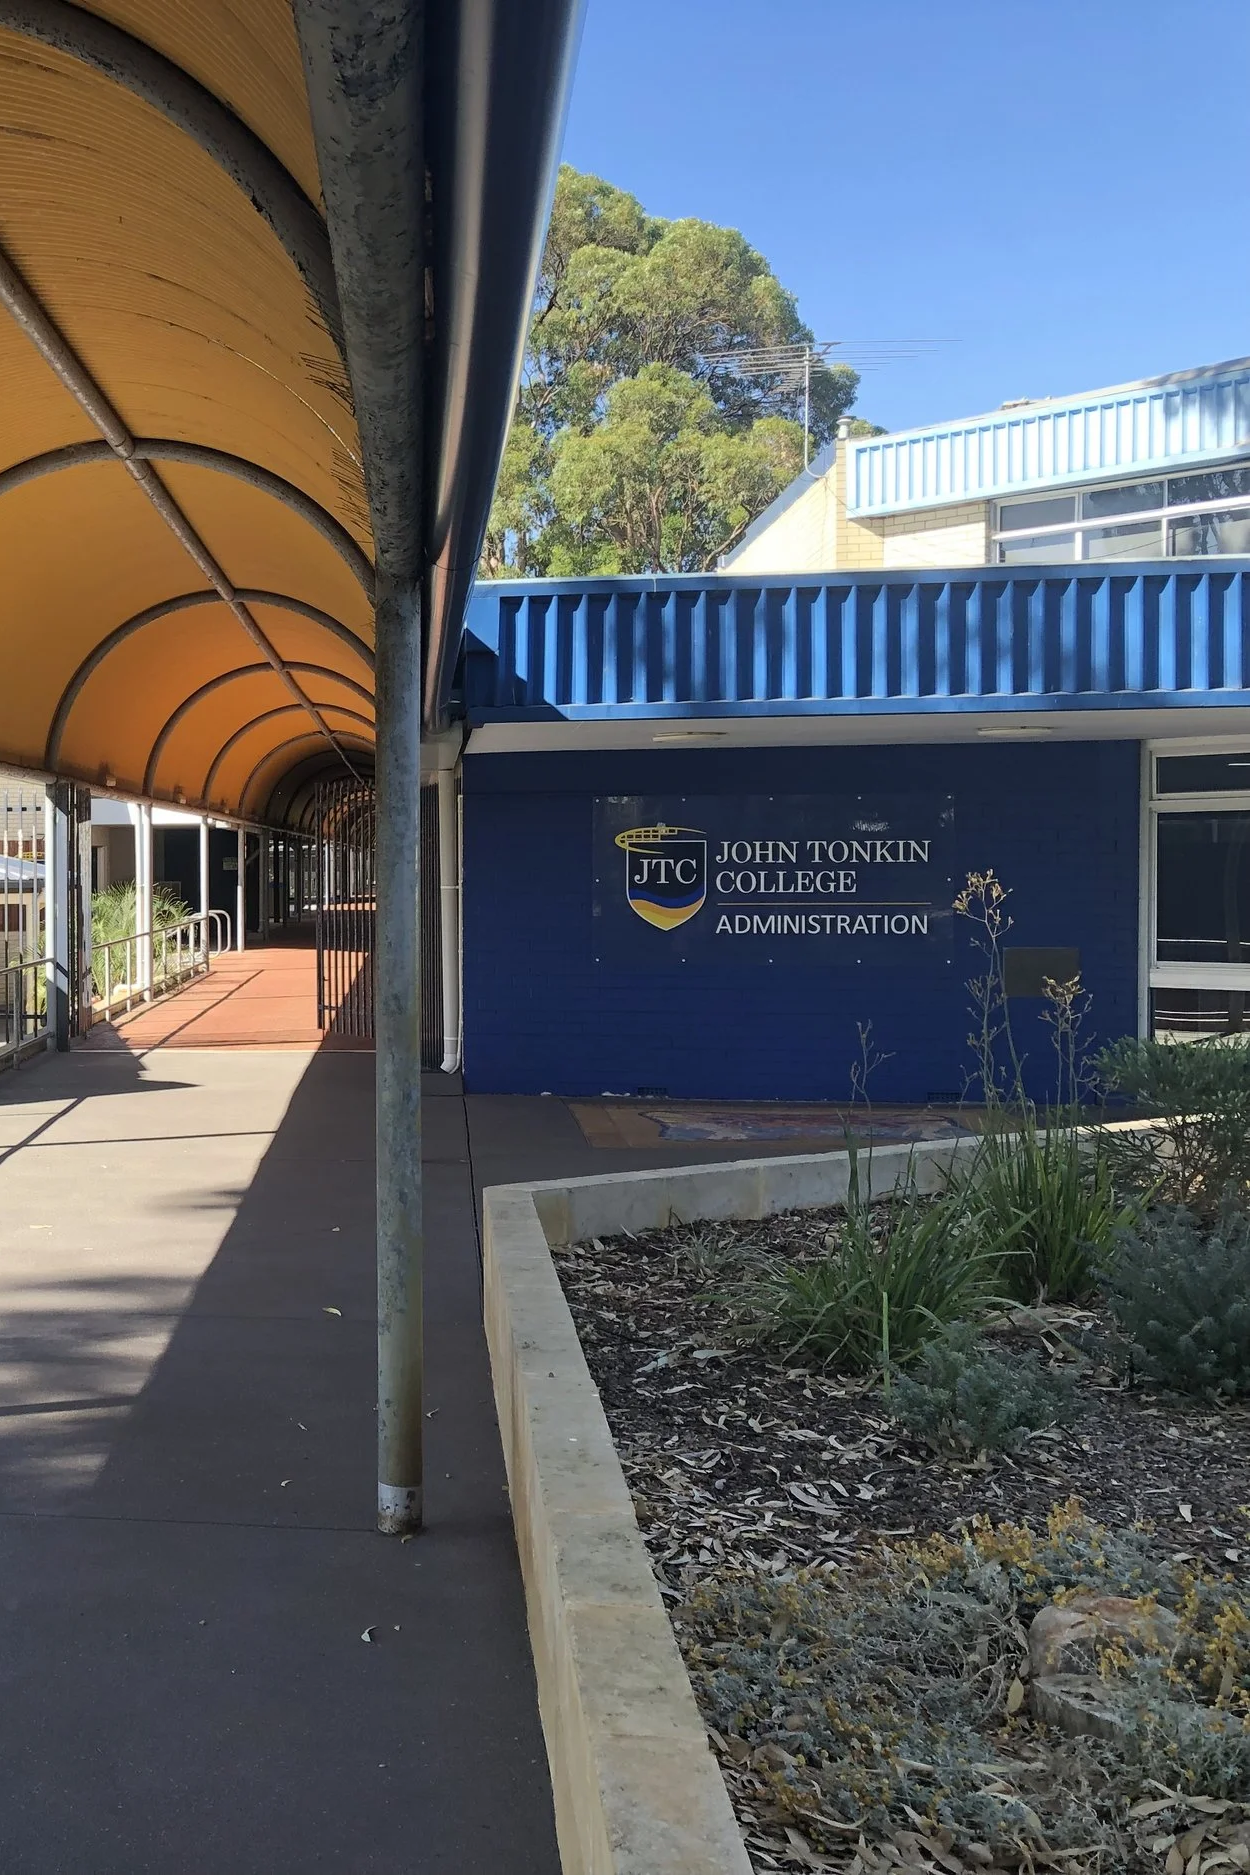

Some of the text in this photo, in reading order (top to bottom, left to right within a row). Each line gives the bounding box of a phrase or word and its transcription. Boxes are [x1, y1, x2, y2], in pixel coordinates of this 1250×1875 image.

[715, 840, 932, 864] JOHN TONKIN
[633, 859, 697, 884] JTC
[715, 870, 857, 894] COLLEGE
[715, 914, 928, 935] ADMINISTRATION
